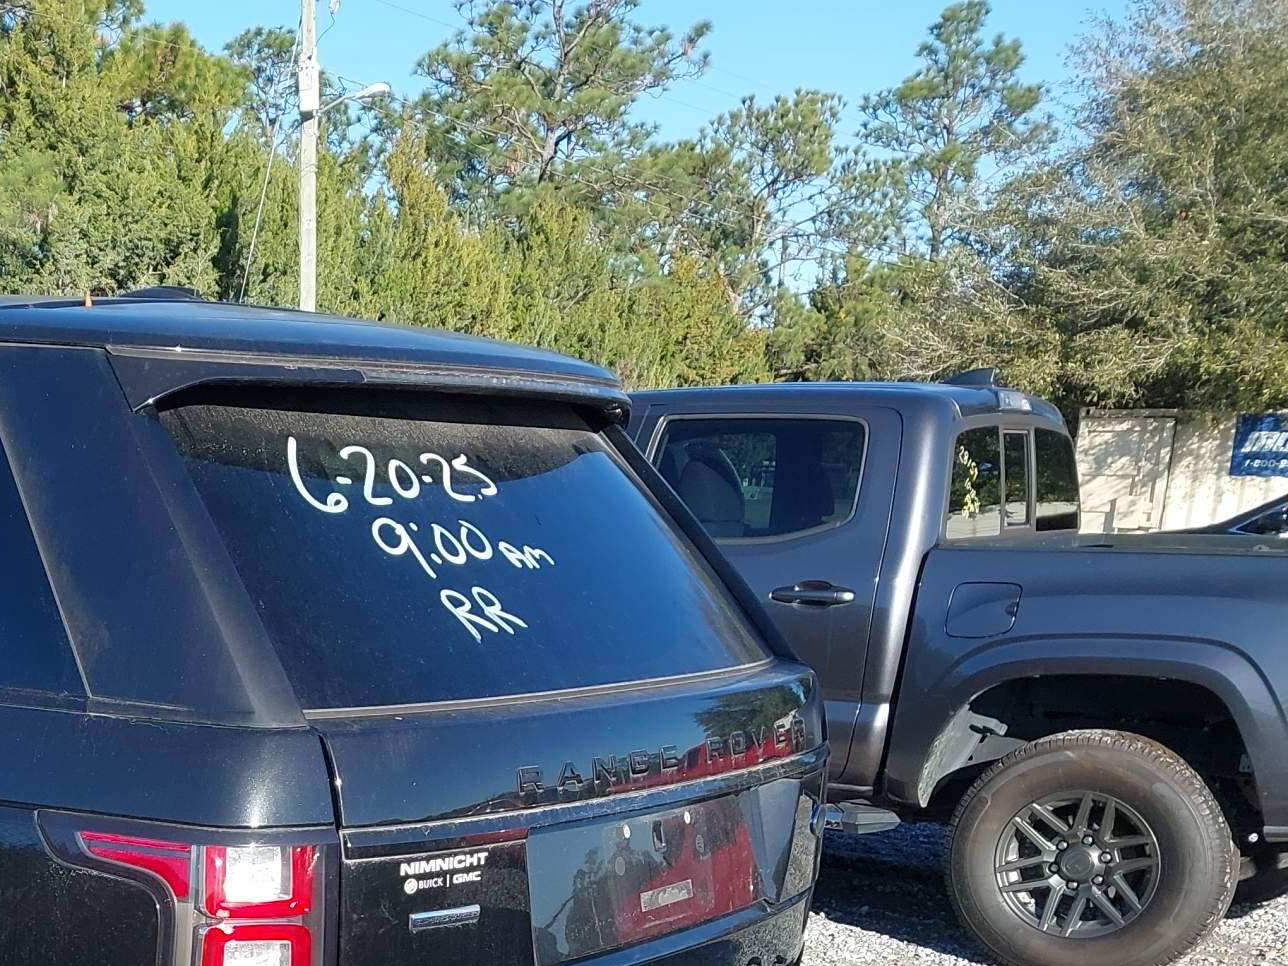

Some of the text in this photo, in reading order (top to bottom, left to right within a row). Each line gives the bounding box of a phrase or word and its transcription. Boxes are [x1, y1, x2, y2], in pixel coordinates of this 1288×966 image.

[288, 436, 498, 513] 6-20-25
[371, 517, 494, 579] 9:00
[440, 586, 528, 644] RR
[516, 712, 806, 797] RANGE ROVER
[400, 852, 489, 876] NIMNICHT
[418, 871, 482, 889] BUICK GMC
